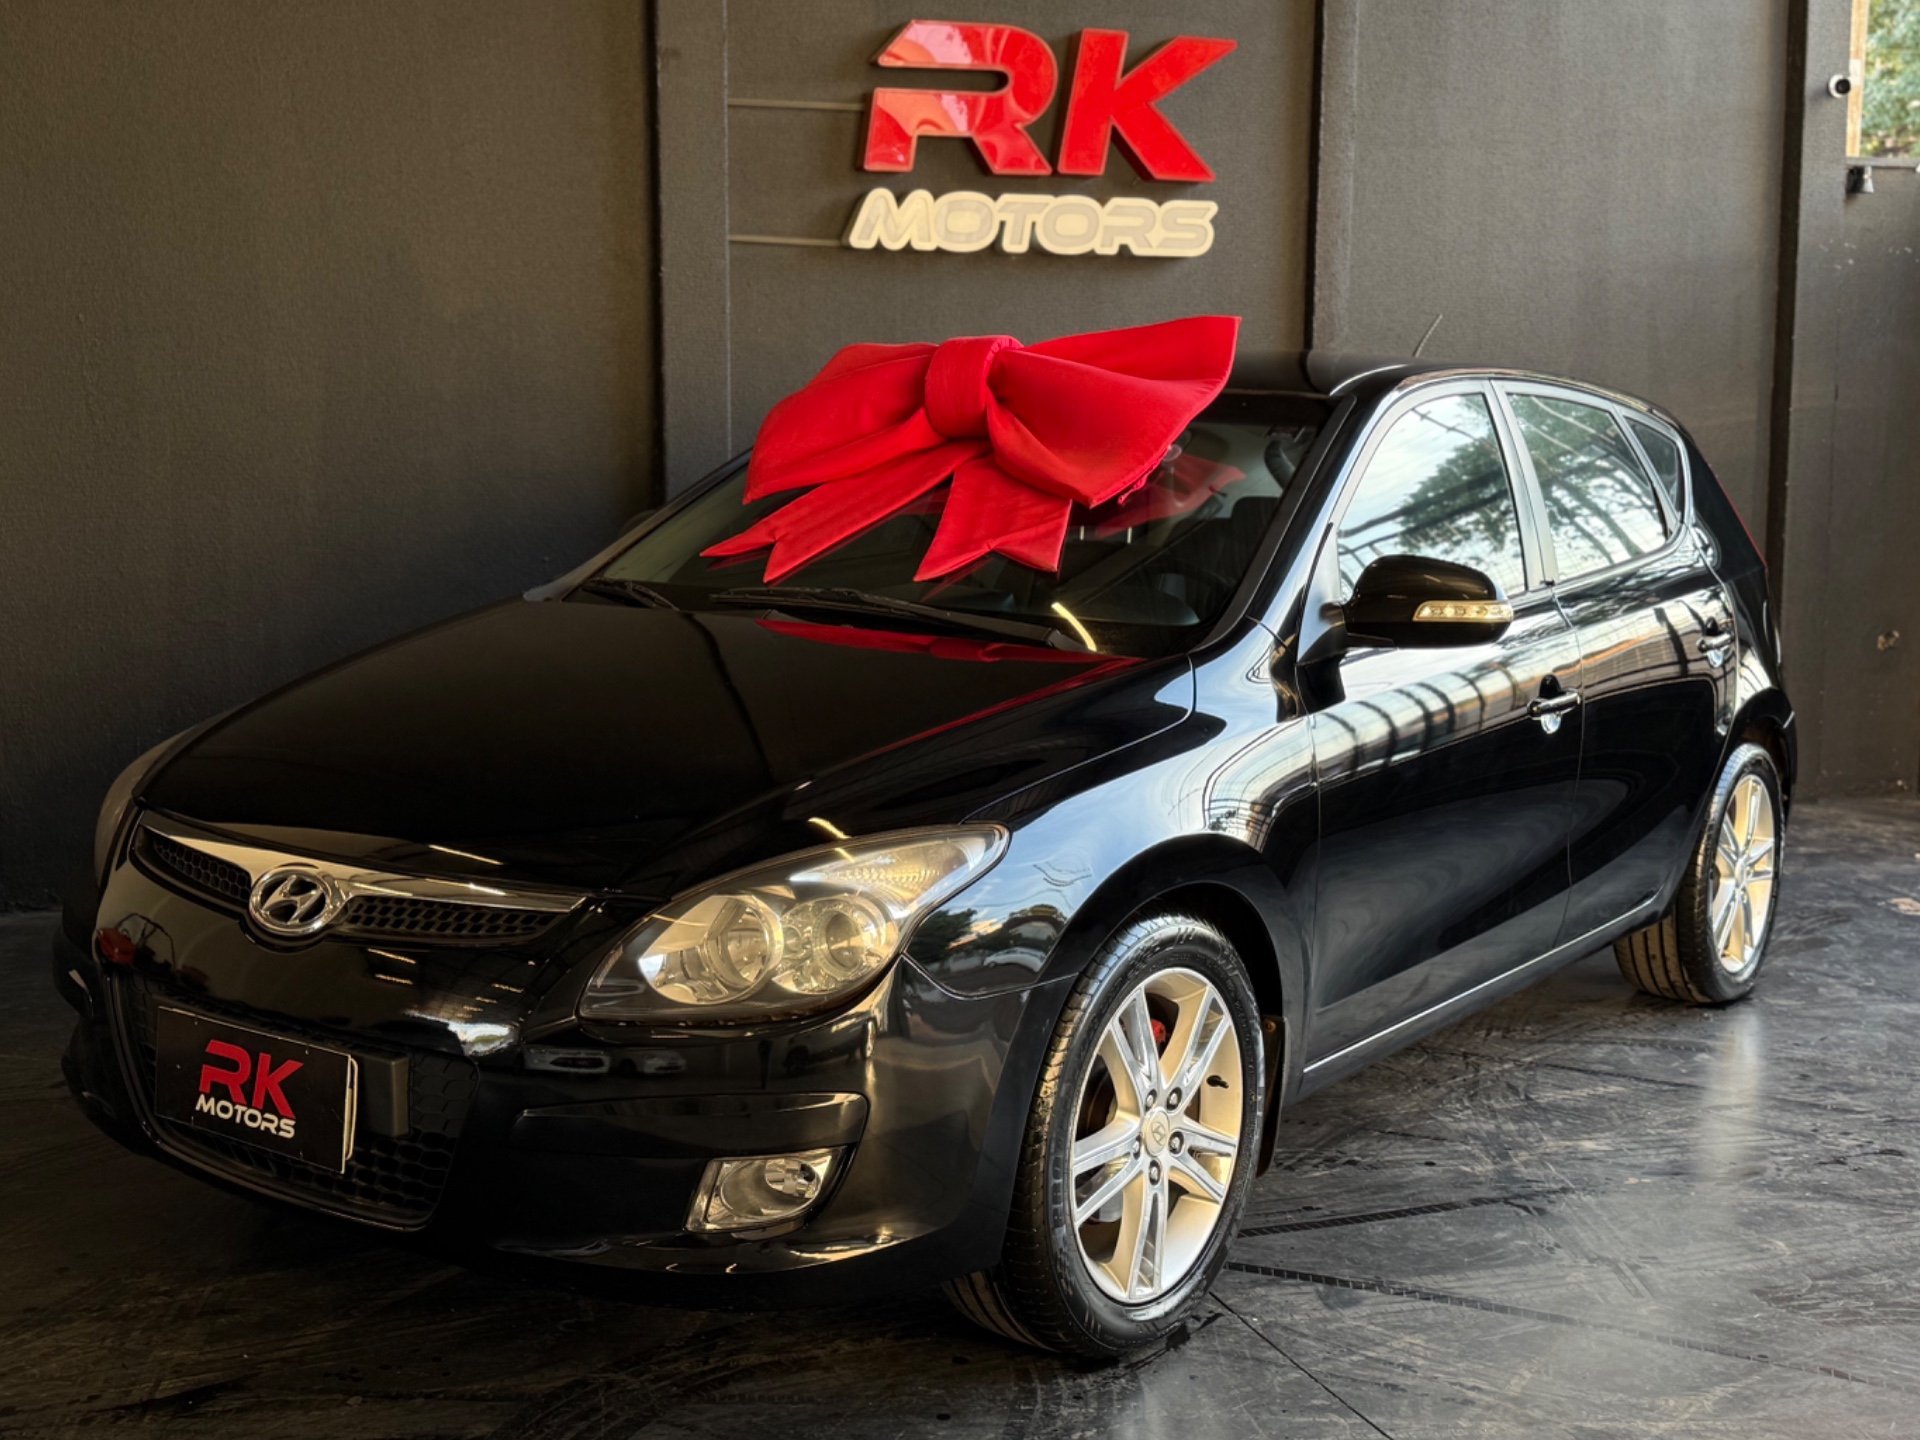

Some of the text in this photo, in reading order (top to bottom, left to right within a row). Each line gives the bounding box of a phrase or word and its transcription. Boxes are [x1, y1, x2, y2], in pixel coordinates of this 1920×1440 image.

[863, 19, 1238, 183] RK
[848, 187, 1218, 258] MOTORS
[195, 1094, 296, 1139] MOTORS
[199, 1039, 304, 1119] RK
